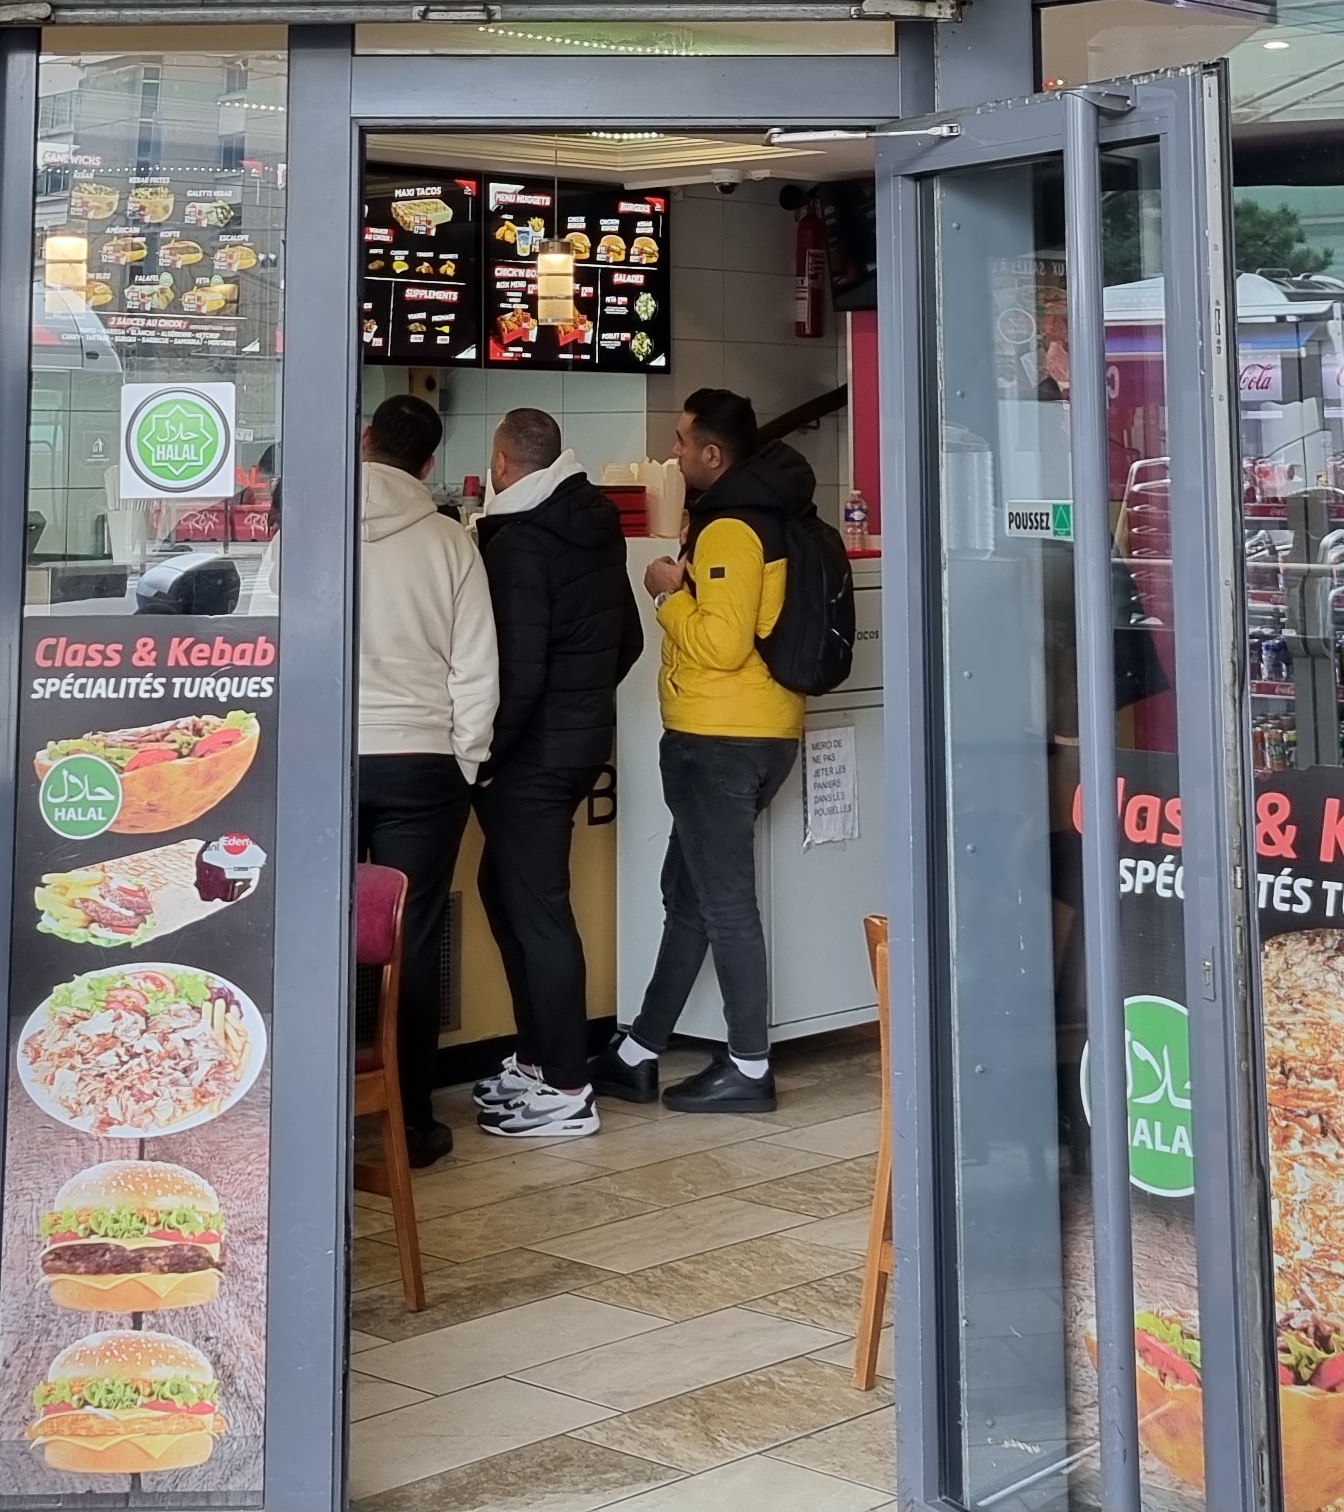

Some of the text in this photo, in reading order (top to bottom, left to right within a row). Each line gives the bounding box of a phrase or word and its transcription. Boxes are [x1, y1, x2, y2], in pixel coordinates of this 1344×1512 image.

[44, 151, 102, 166] SANDWICHS
[395, 187, 441, 197] MAXI TACOS
[156, 444, 199, 461] HALAL
[1008, 510, 1051, 533] POUSSEZ
[34, 636, 275, 668] Class & Kebab
[31, 673, 274, 701] SPÉCIALITÉS TURQUES
[54, 807, 106, 821] HALAL
[1256, 791, 1297, 859] &
